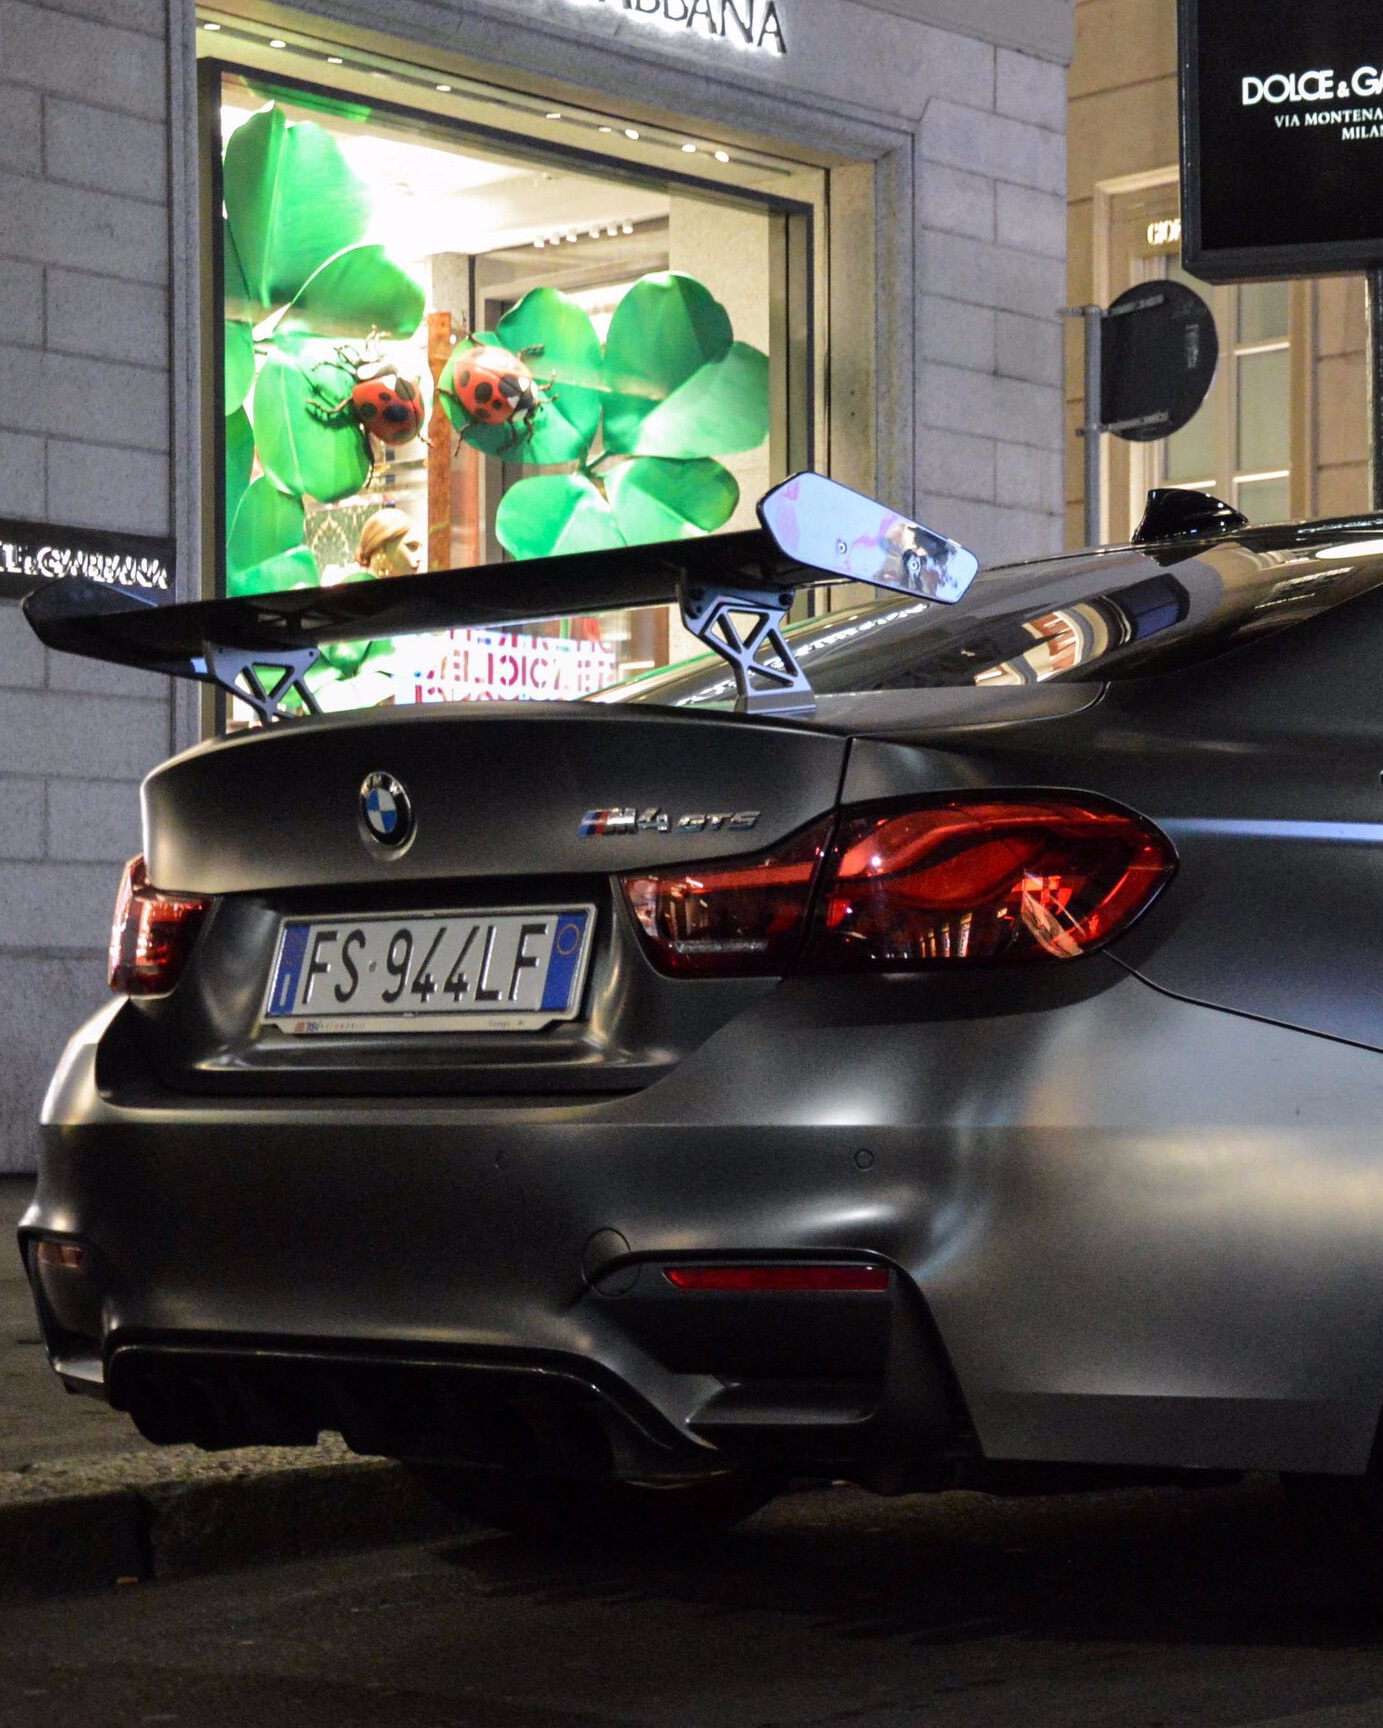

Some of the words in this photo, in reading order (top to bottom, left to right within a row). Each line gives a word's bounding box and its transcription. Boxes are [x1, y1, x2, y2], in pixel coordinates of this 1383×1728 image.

[1274, 114, 1301, 128] VIA
[676, 810, 761, 833] GTS
[302, 928, 367, 1005] FS
[381, 922, 549, 1004] 944LF
